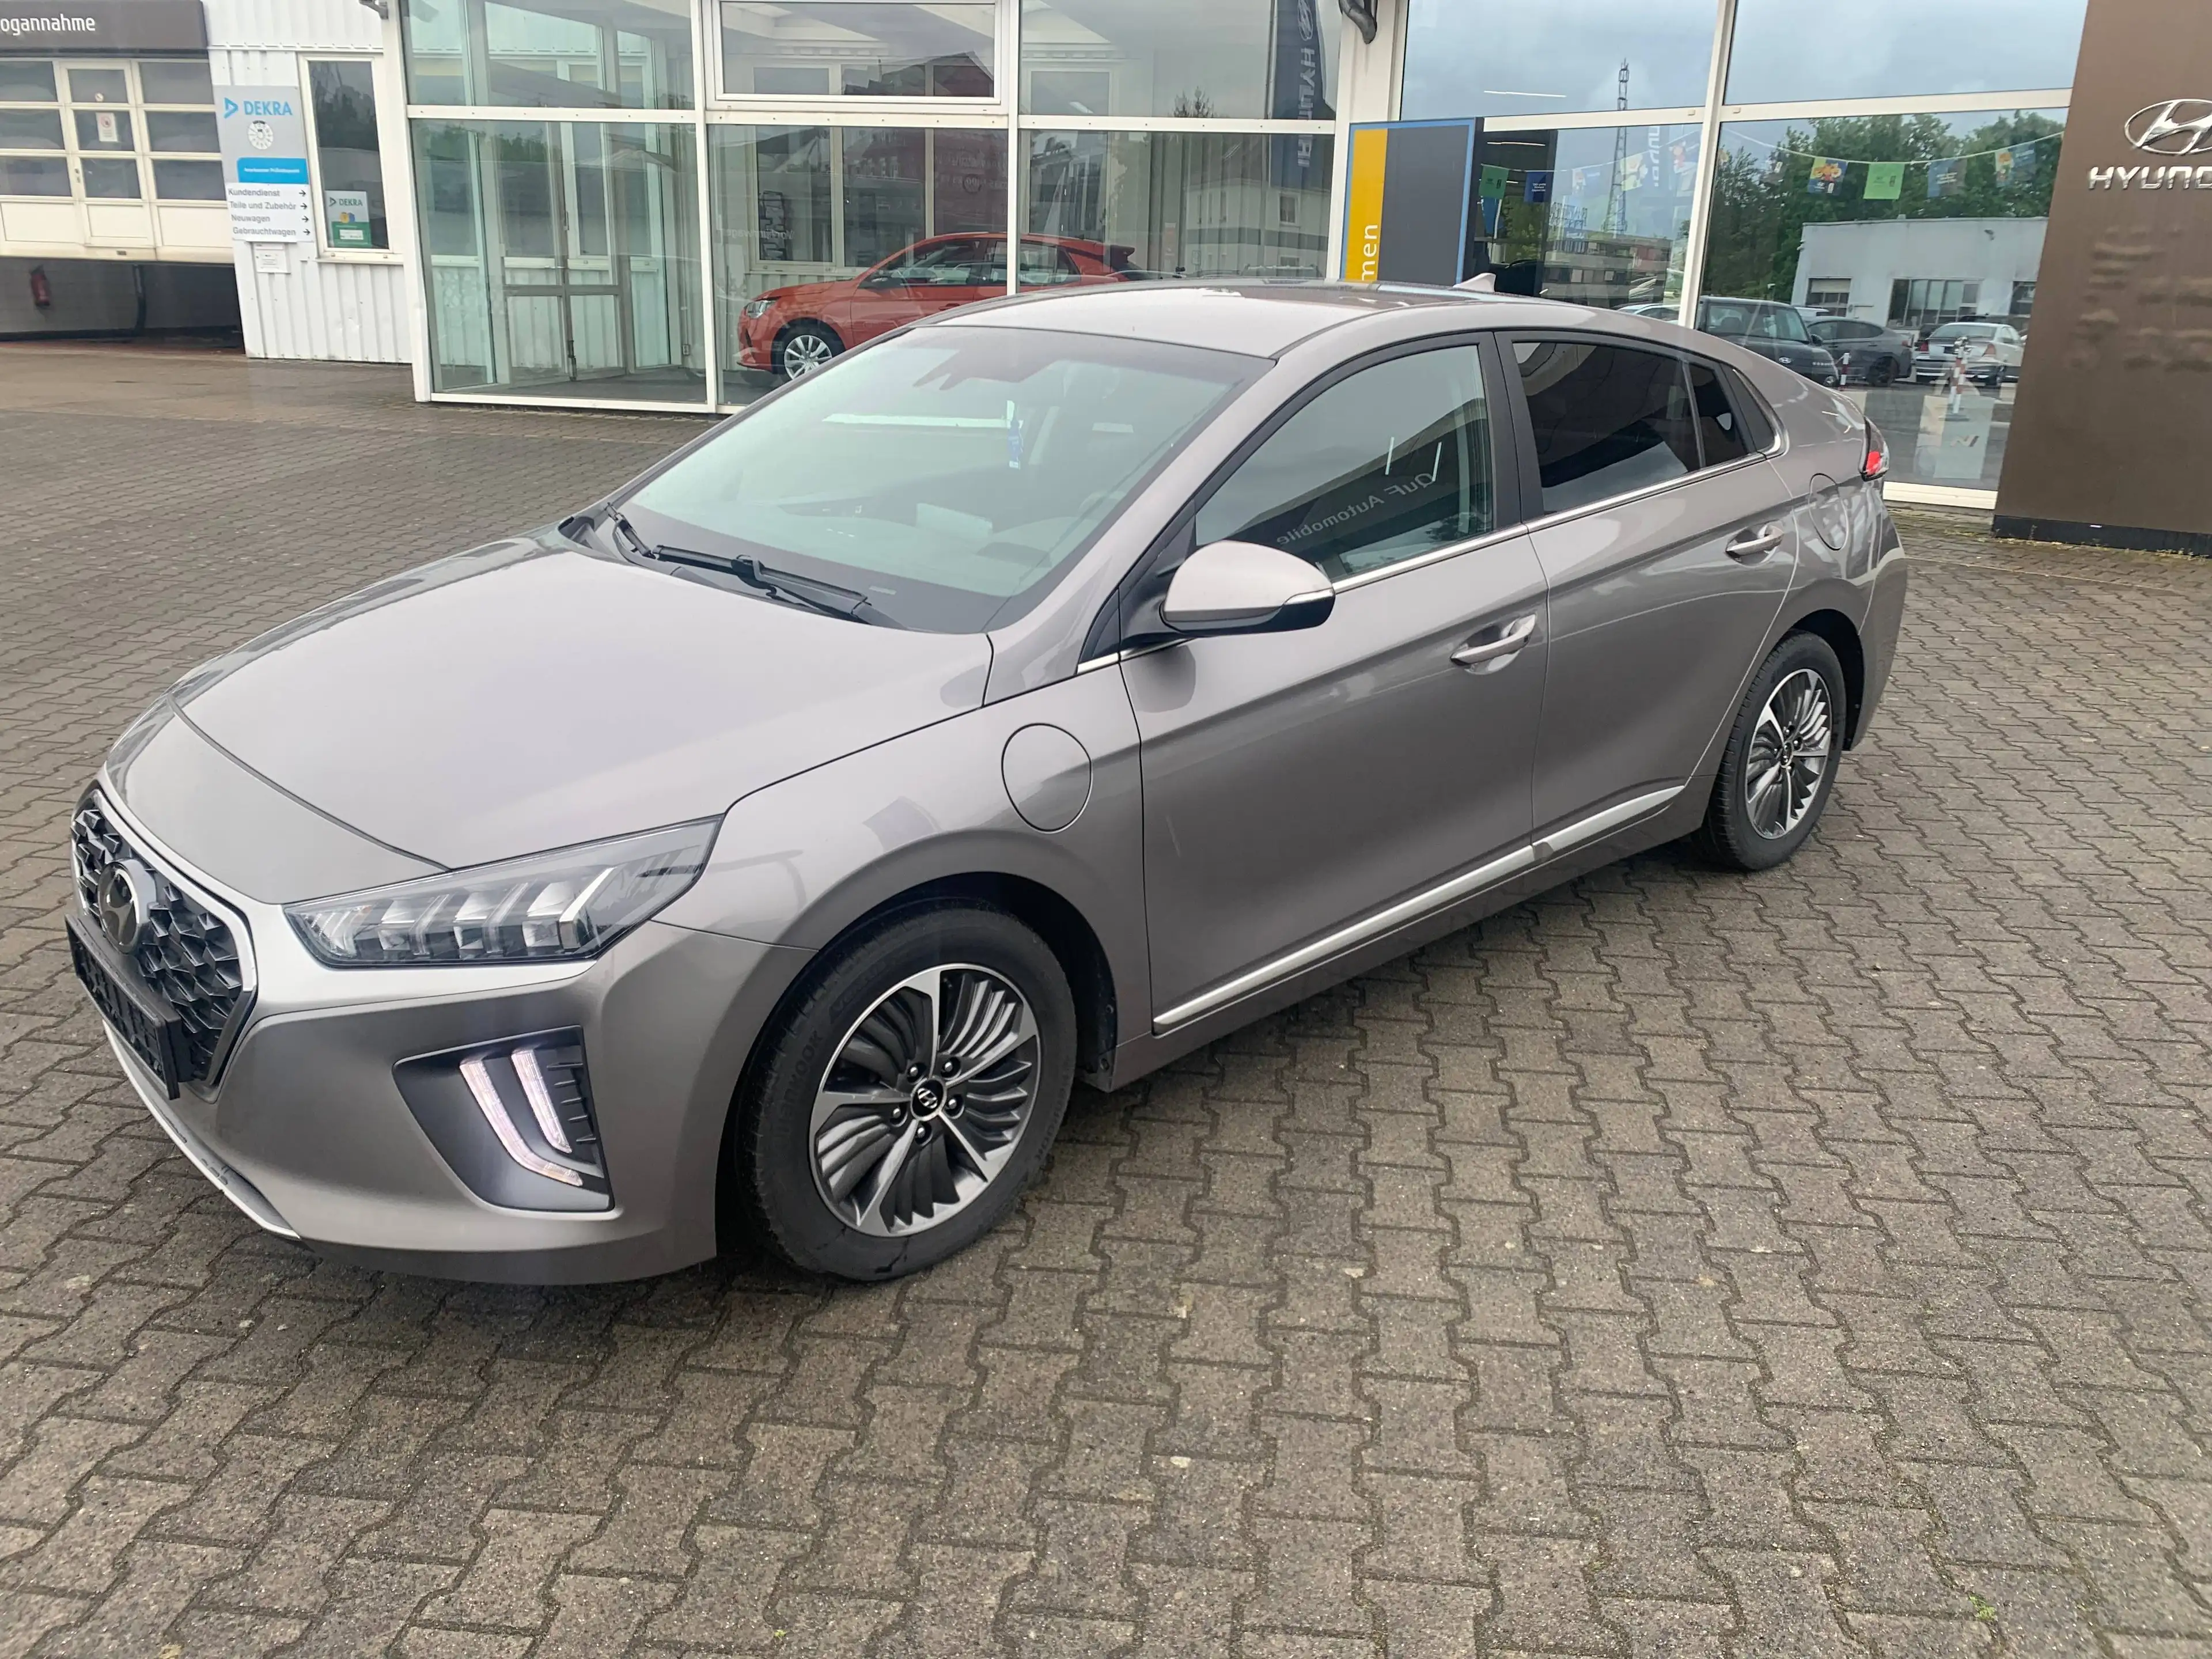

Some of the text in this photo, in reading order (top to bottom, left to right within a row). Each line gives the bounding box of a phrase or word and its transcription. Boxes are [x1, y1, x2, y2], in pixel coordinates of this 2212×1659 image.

[243, 101, 293, 116] DEKRA
[228, 188, 281, 196] Kundendienst
[230, 200, 247, 209] Teile
[264, 202, 297, 210] Zubehör
[339, 198, 363, 206] DEKRA
[231, 214, 270, 224] Neuwagen
[233, 226, 296, 237] Gebrauchtwagen
